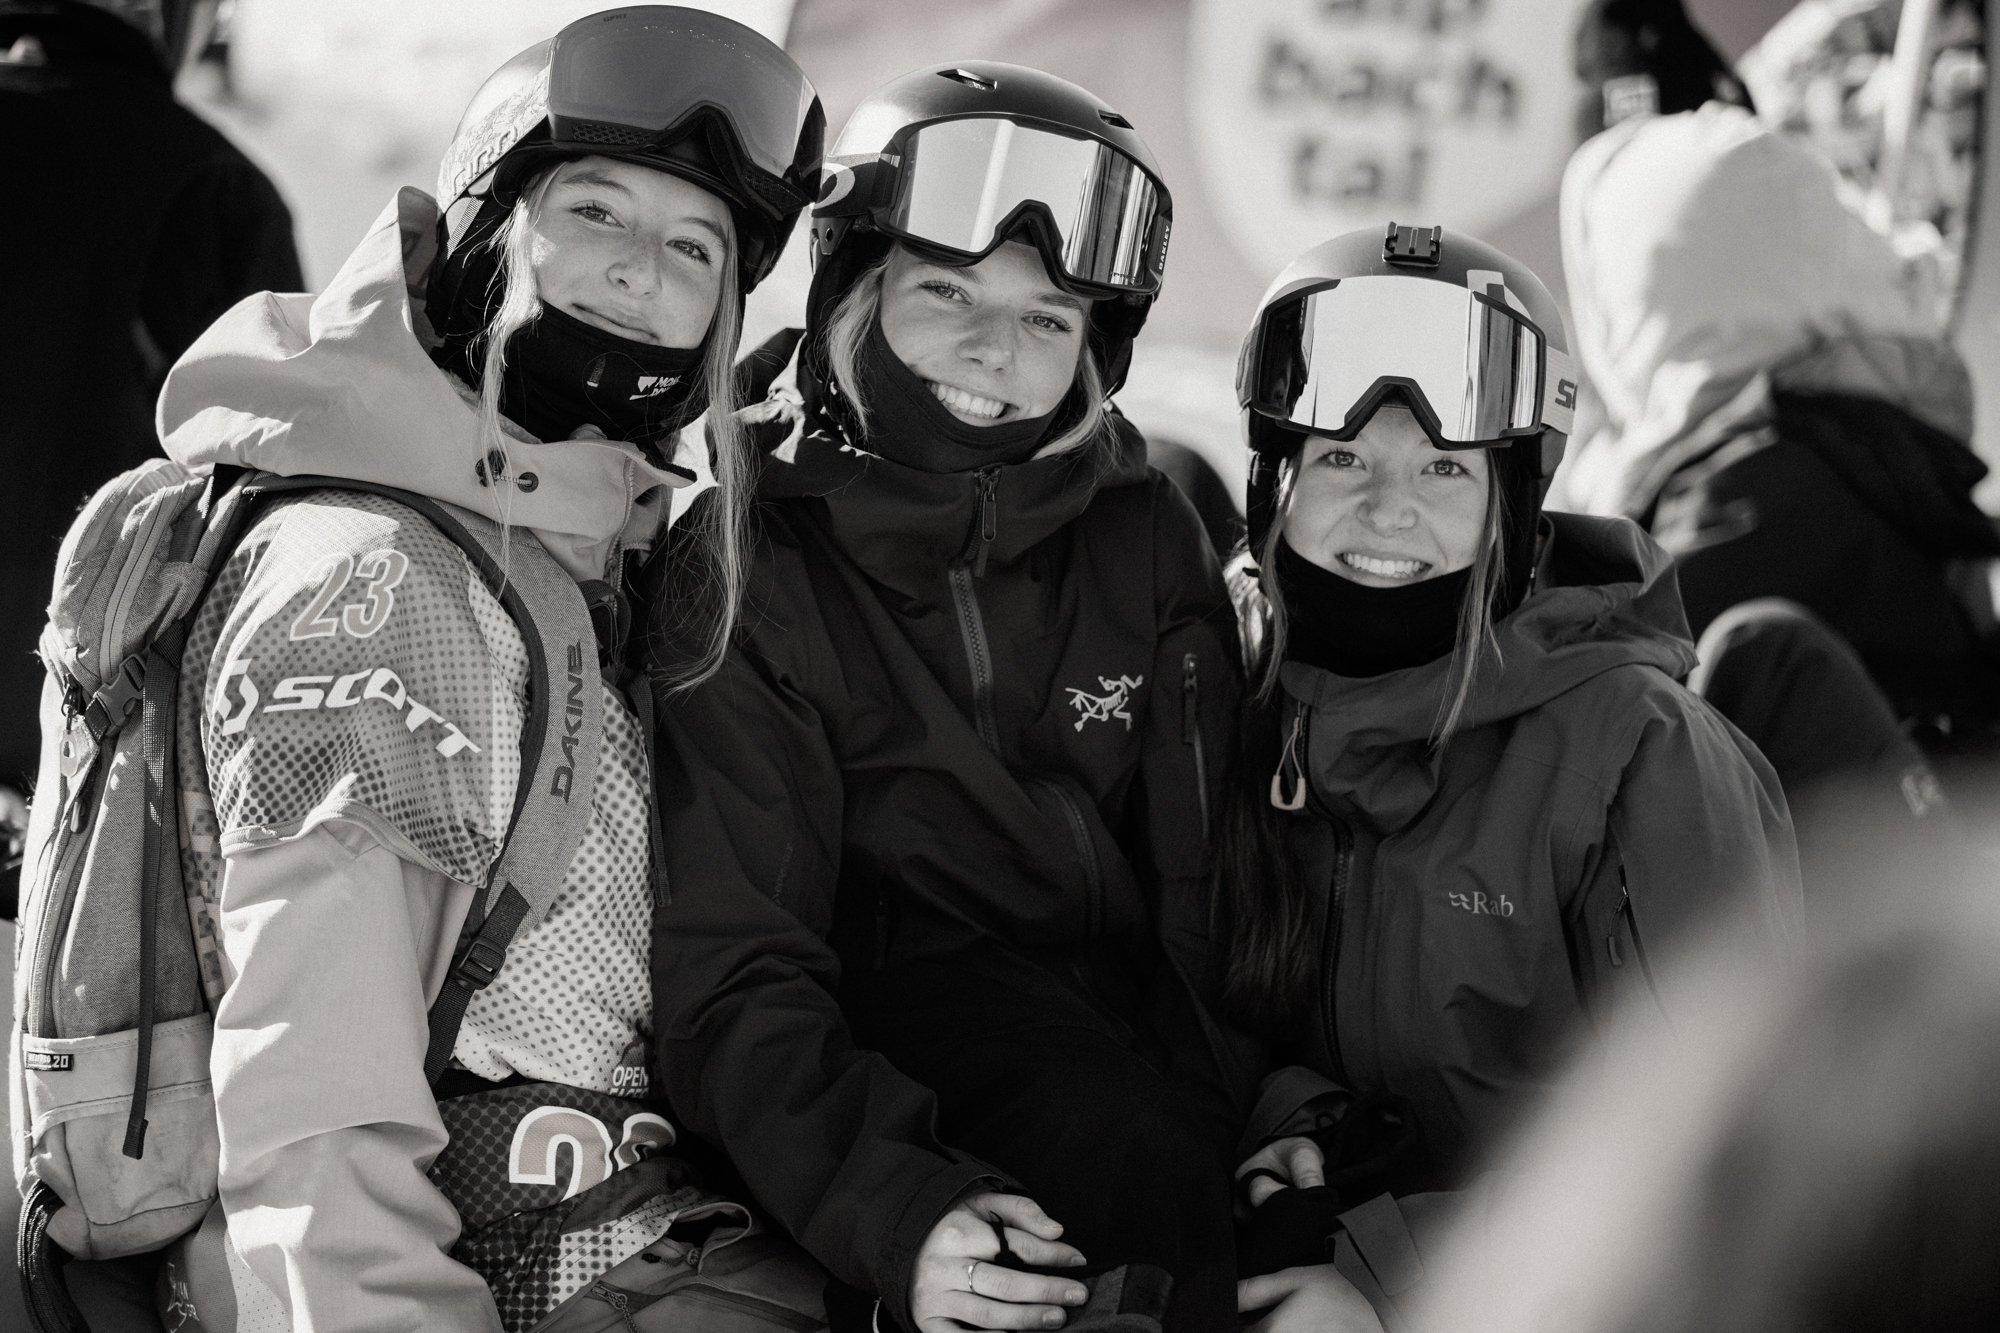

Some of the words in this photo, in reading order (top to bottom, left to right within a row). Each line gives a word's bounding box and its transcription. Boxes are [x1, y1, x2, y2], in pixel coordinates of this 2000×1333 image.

[1158, 225, 1170, 270] OAKLEY
[289, 549, 410, 642] 23
[262, 667, 483, 758] SCOTT
[550, 639, 584, 804] DAKINE
[1471, 891, 1514, 918] Rab
[53, 1055, 69, 1069] 20
[612, 1065, 649, 1087] OPEN
